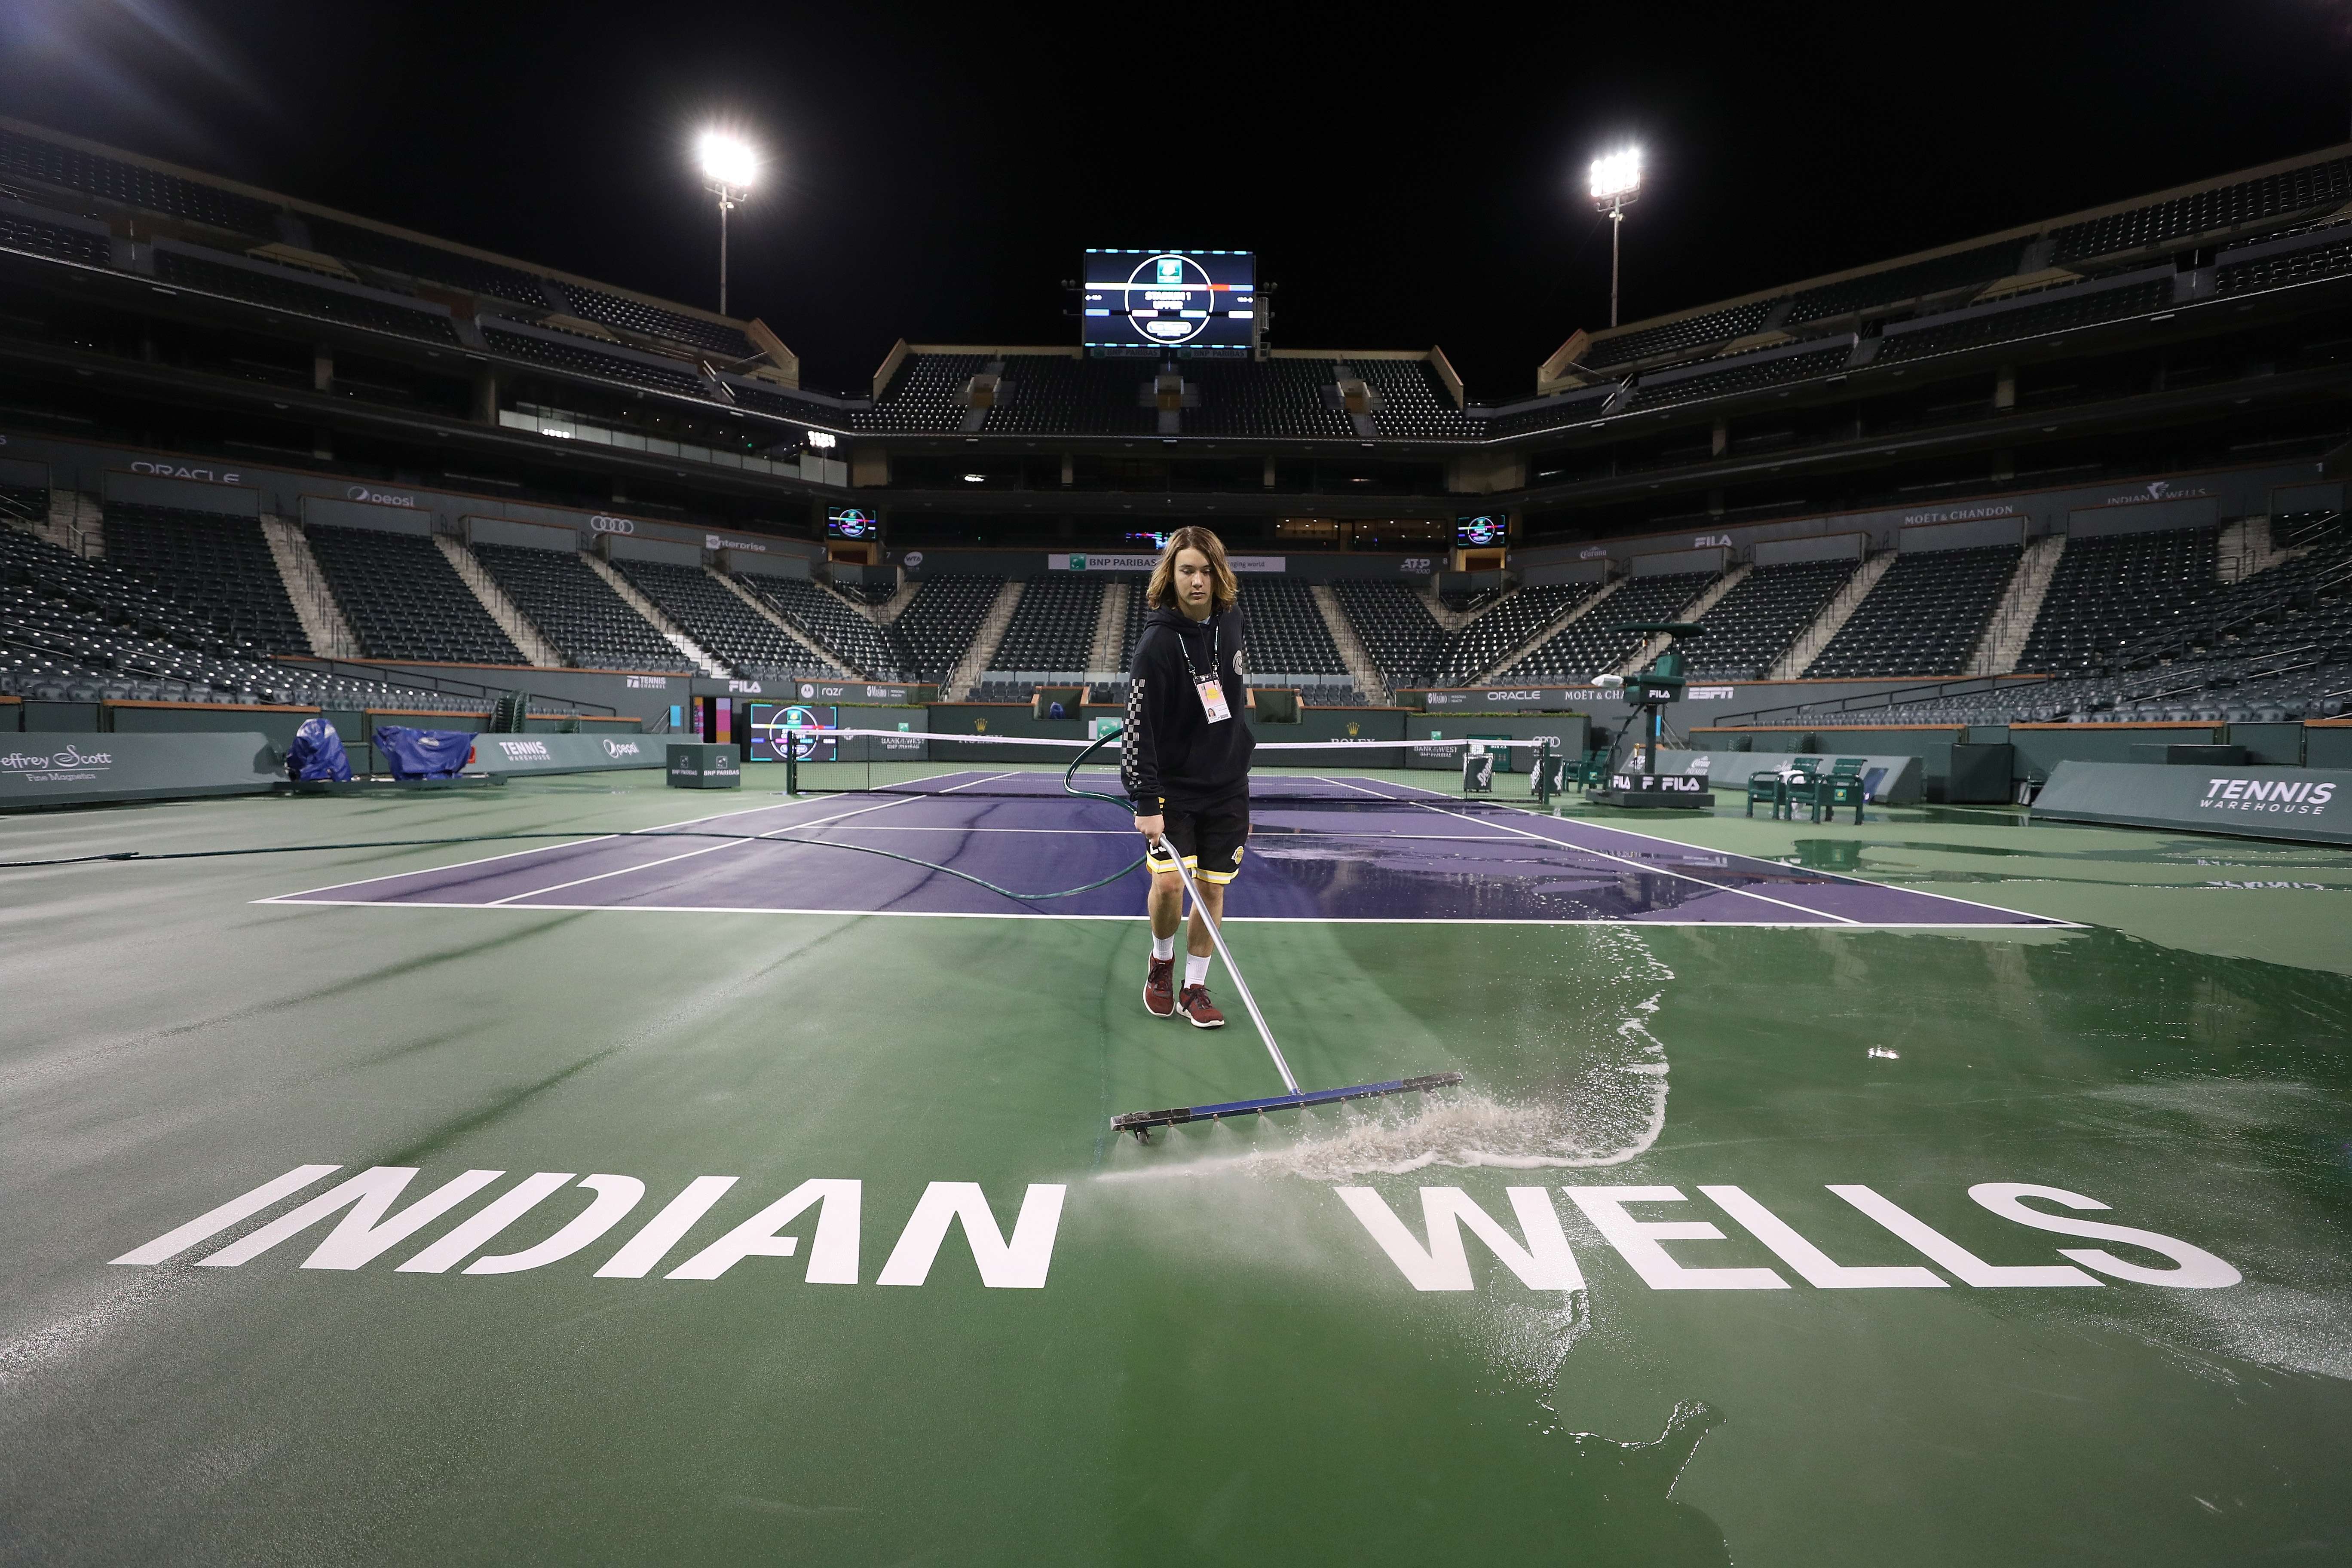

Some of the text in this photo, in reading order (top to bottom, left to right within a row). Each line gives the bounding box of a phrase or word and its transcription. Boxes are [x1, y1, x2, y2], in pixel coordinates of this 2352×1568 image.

[131, 461, 240, 483] ORACLE
[2315, 462, 2323, 472] 1
[2107, 493, 2150, 504] INDIAN
[1950, 505, 2013, 521] CHANDON
[1694, 534, 1732, 548] FILA
[1113, 558, 1157, 567] PARIBAS
[1400, 558, 1430, 568] ATP
[729, 680, 762, 693] FILA
[821, 687, 843, 696] razr
[1688, 687, 1734, 699] ESPN
[1487, 690, 1540, 701] ORACLE
[1565, 689, 1595, 700] MOËT
[1649, 689, 1671, 698] FILA
[499, 741, 548, 756] TENNIS
[616, 742, 640, 757] pepsi
[0, 744, 112, 769] effrey Scott
[26, 774, 48, 782] Fine
[1613, 775, 1631, 790] FILA
[1662, 777, 1700, 791] FILA
[2206, 778, 2337, 805] TENNIS
[2200, 799, 2326, 815] WAREHOUSE
[106, 1164, 2242, 1291] INDIAN WELLS
